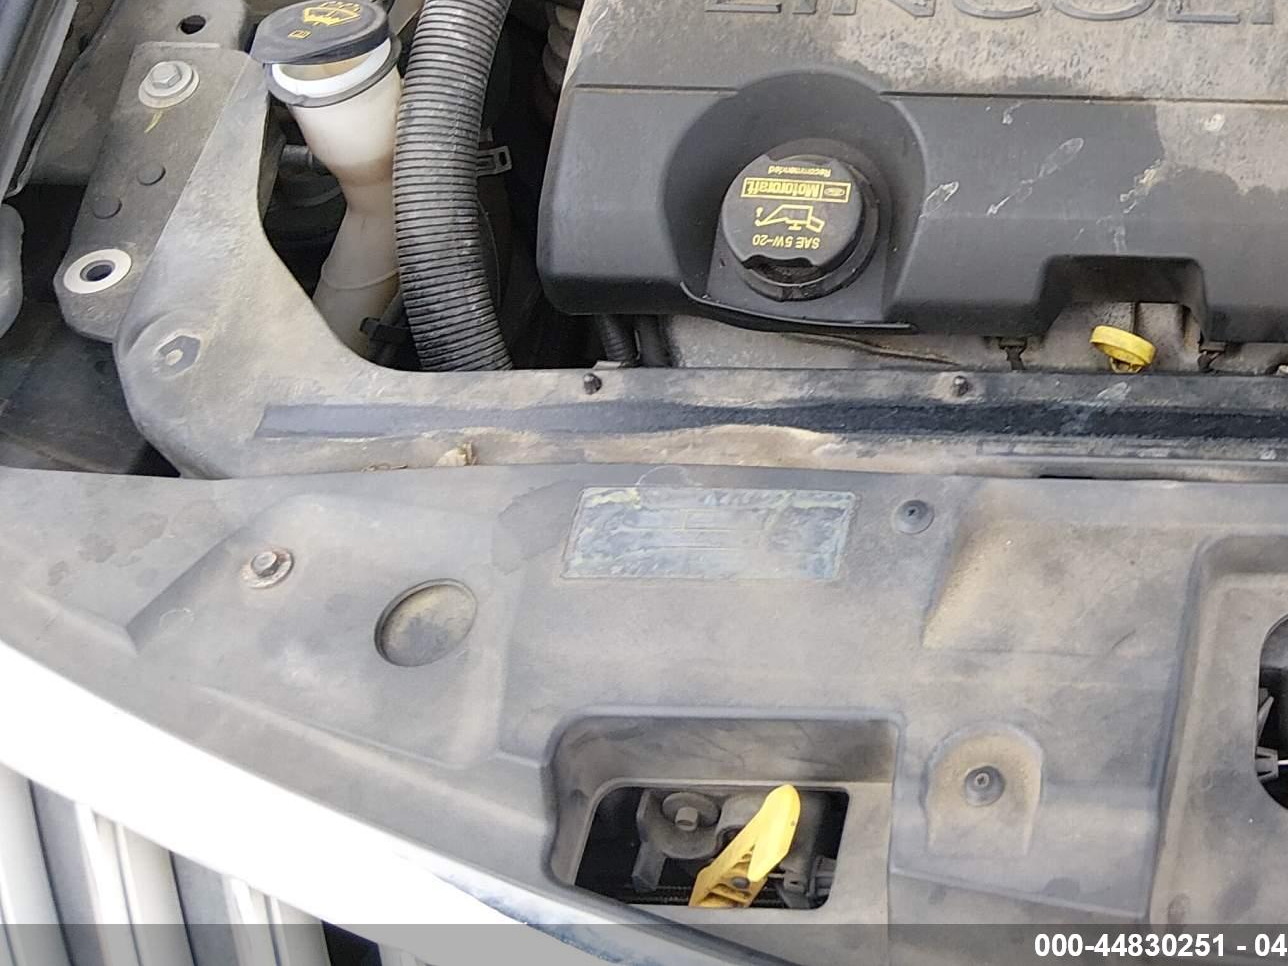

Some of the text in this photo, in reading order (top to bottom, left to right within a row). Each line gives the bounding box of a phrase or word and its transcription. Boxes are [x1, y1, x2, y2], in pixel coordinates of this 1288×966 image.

[768, 166, 831, 177] Recommended
[747, 181, 819, 197] Motorcraft
[753, 235, 820, 249] SAE 5W-20
